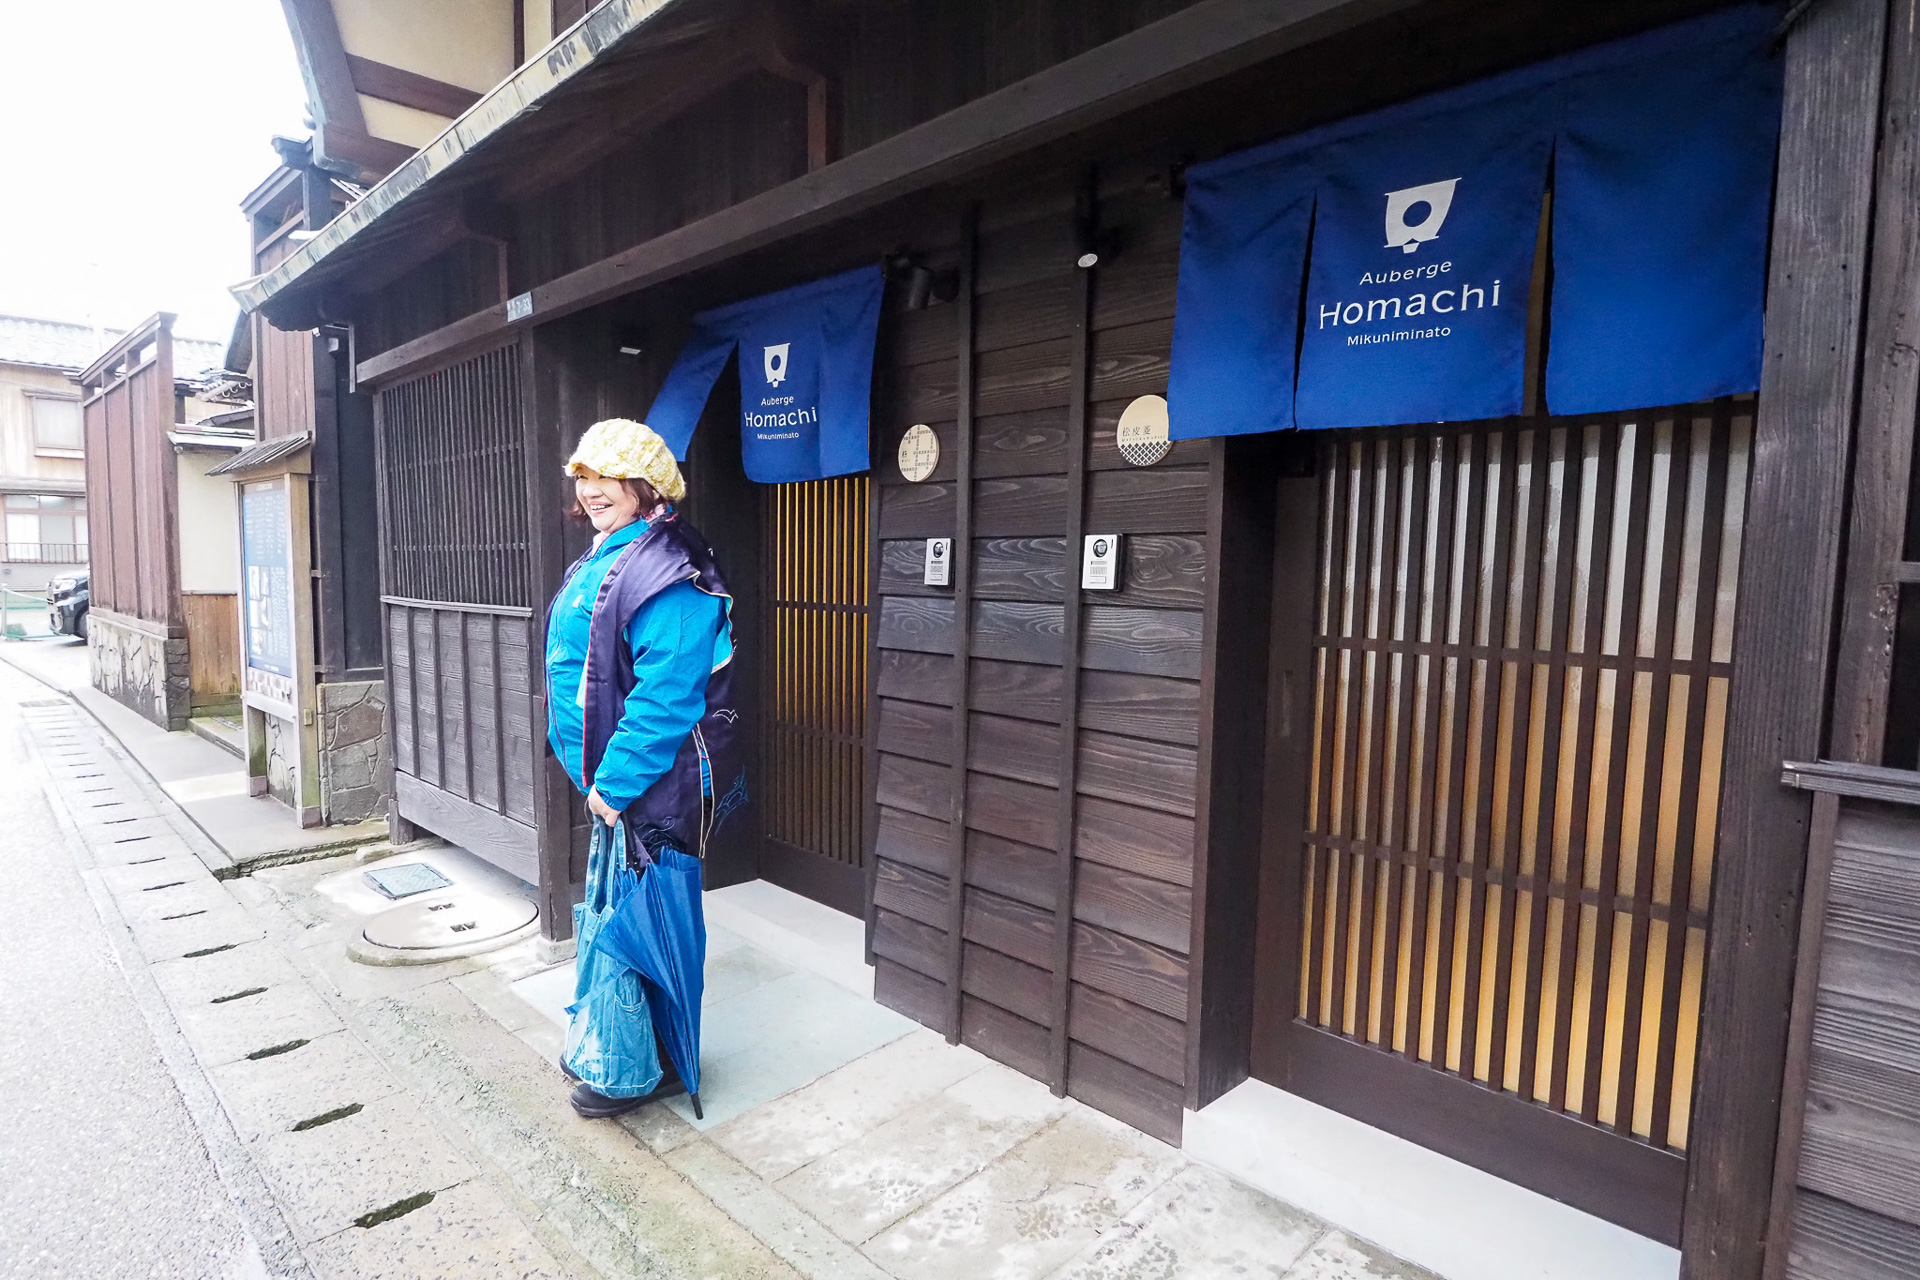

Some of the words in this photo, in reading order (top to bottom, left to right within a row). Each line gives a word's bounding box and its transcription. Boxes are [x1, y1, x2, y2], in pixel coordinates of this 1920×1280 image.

[1359, 261, 1452, 286] Auberge
[1319, 279, 1501, 330] Homachi
[1347, 326, 1451, 346] Mikuniminato
[760, 395, 794, 406] Auberge
[744, 406, 818, 428] Homachi
[756, 432, 800, 440] Mikuniminato
